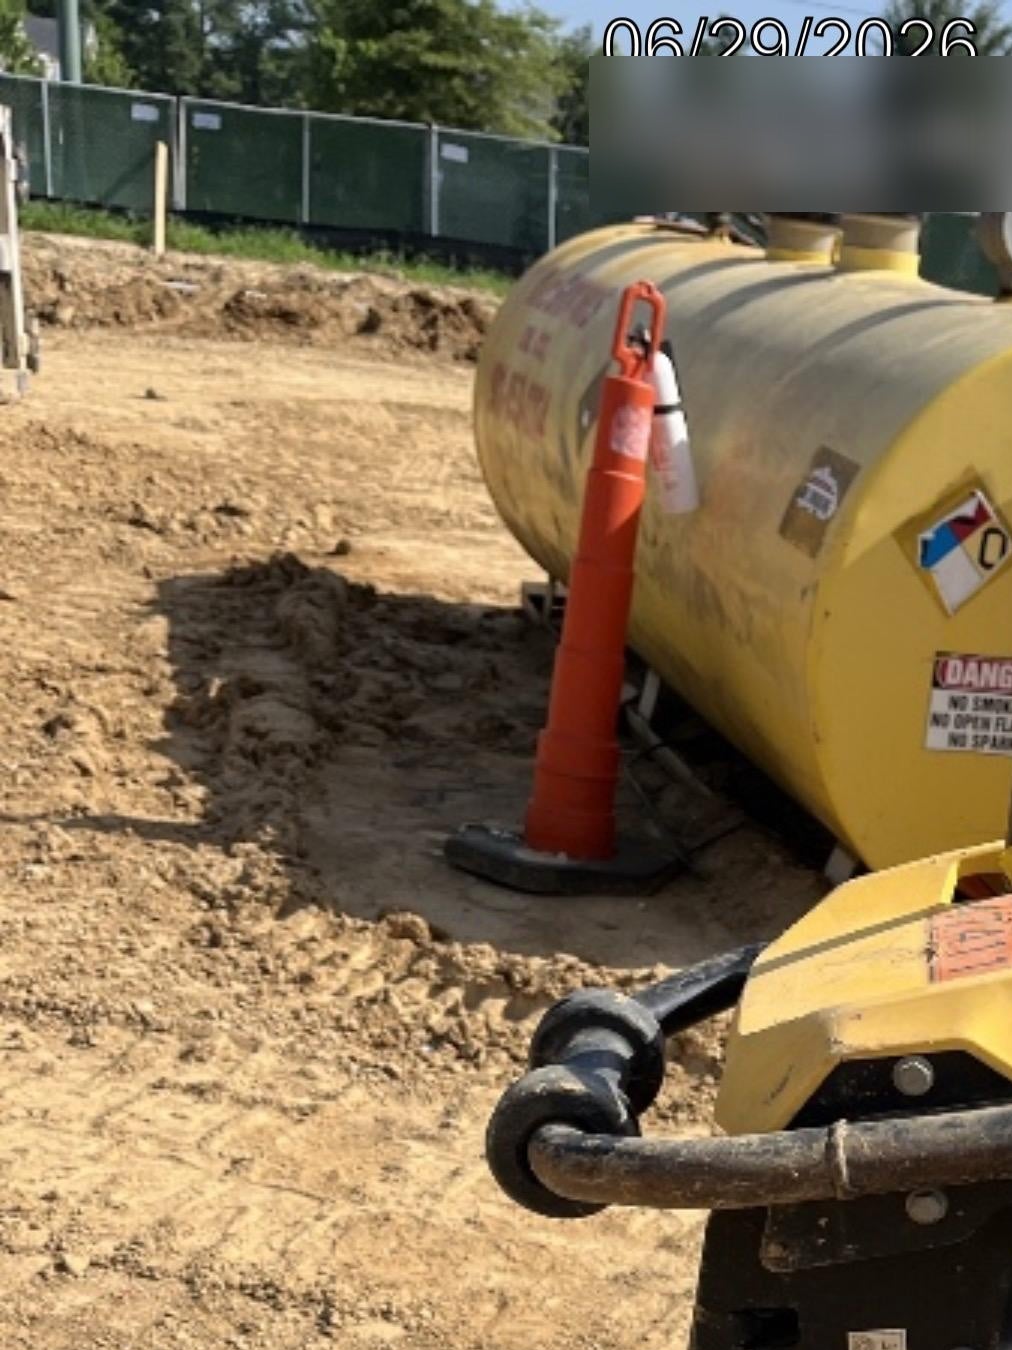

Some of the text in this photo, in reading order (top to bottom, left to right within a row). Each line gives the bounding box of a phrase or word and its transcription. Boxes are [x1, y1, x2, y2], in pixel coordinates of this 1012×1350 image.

[930, 712, 950, 728] NO
[953, 714, 991, 730] OPEN
[948, 733, 967, 748] NO
